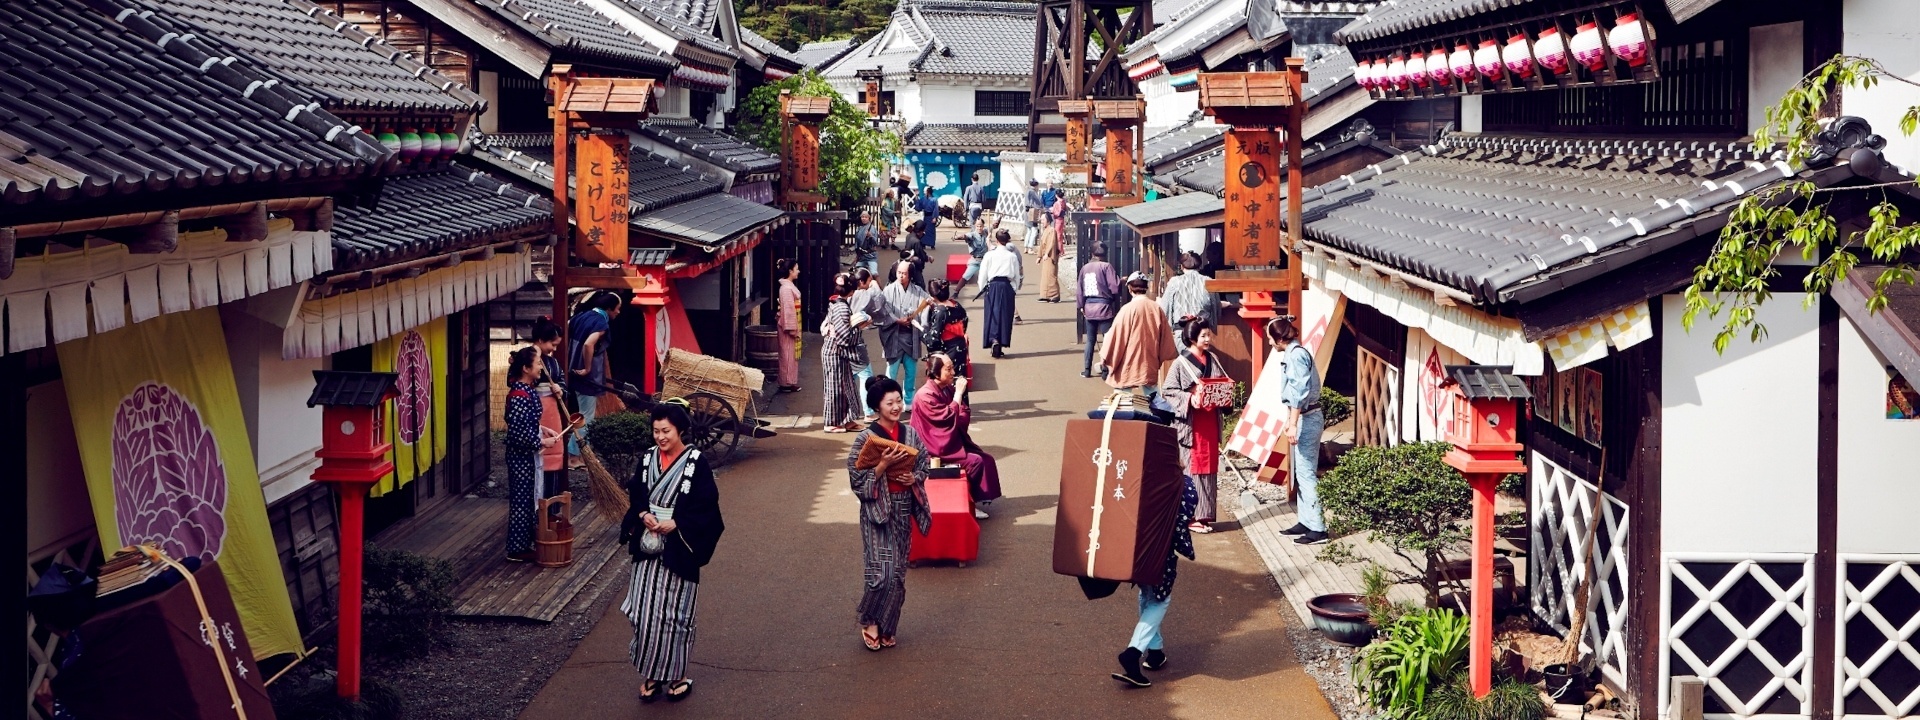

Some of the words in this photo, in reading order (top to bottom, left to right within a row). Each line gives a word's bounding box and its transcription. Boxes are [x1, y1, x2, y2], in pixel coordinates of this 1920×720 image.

[586, 161, 606, 247] こけし堂
[610, 143, 628, 224] 民芸小間物
[1113, 459, 1128, 501] 貸本
[221, 622, 249, 680] 貸本
